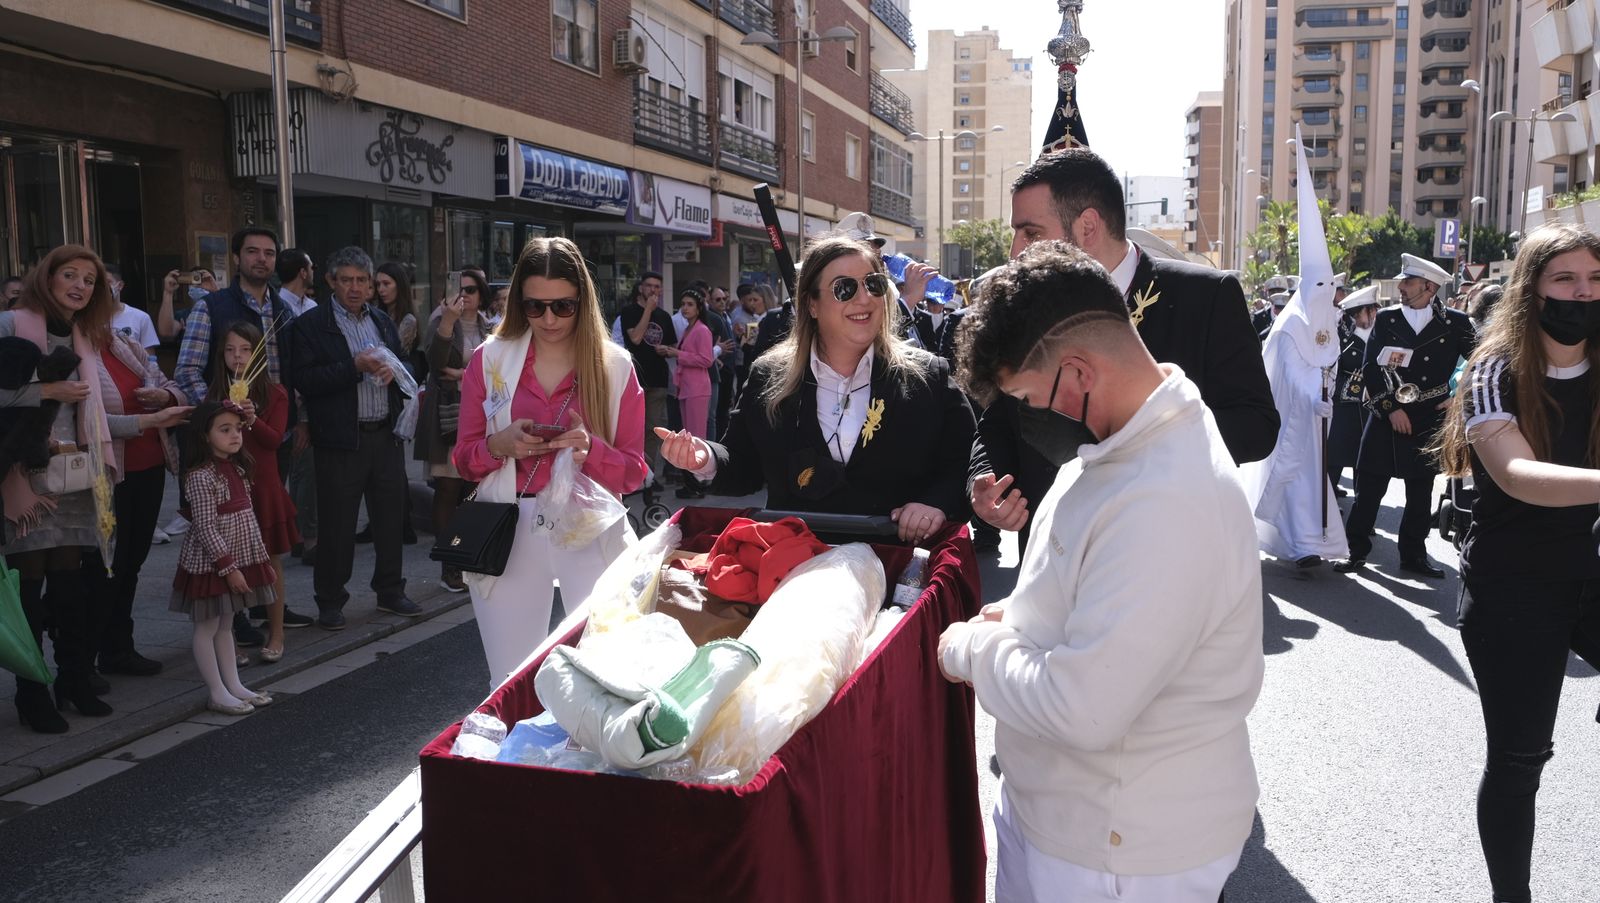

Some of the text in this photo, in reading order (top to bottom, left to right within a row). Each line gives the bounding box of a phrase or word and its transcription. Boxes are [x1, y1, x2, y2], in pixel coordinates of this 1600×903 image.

[531, 148, 623, 199] Don Cabello
[674, 195, 710, 224] Flame
